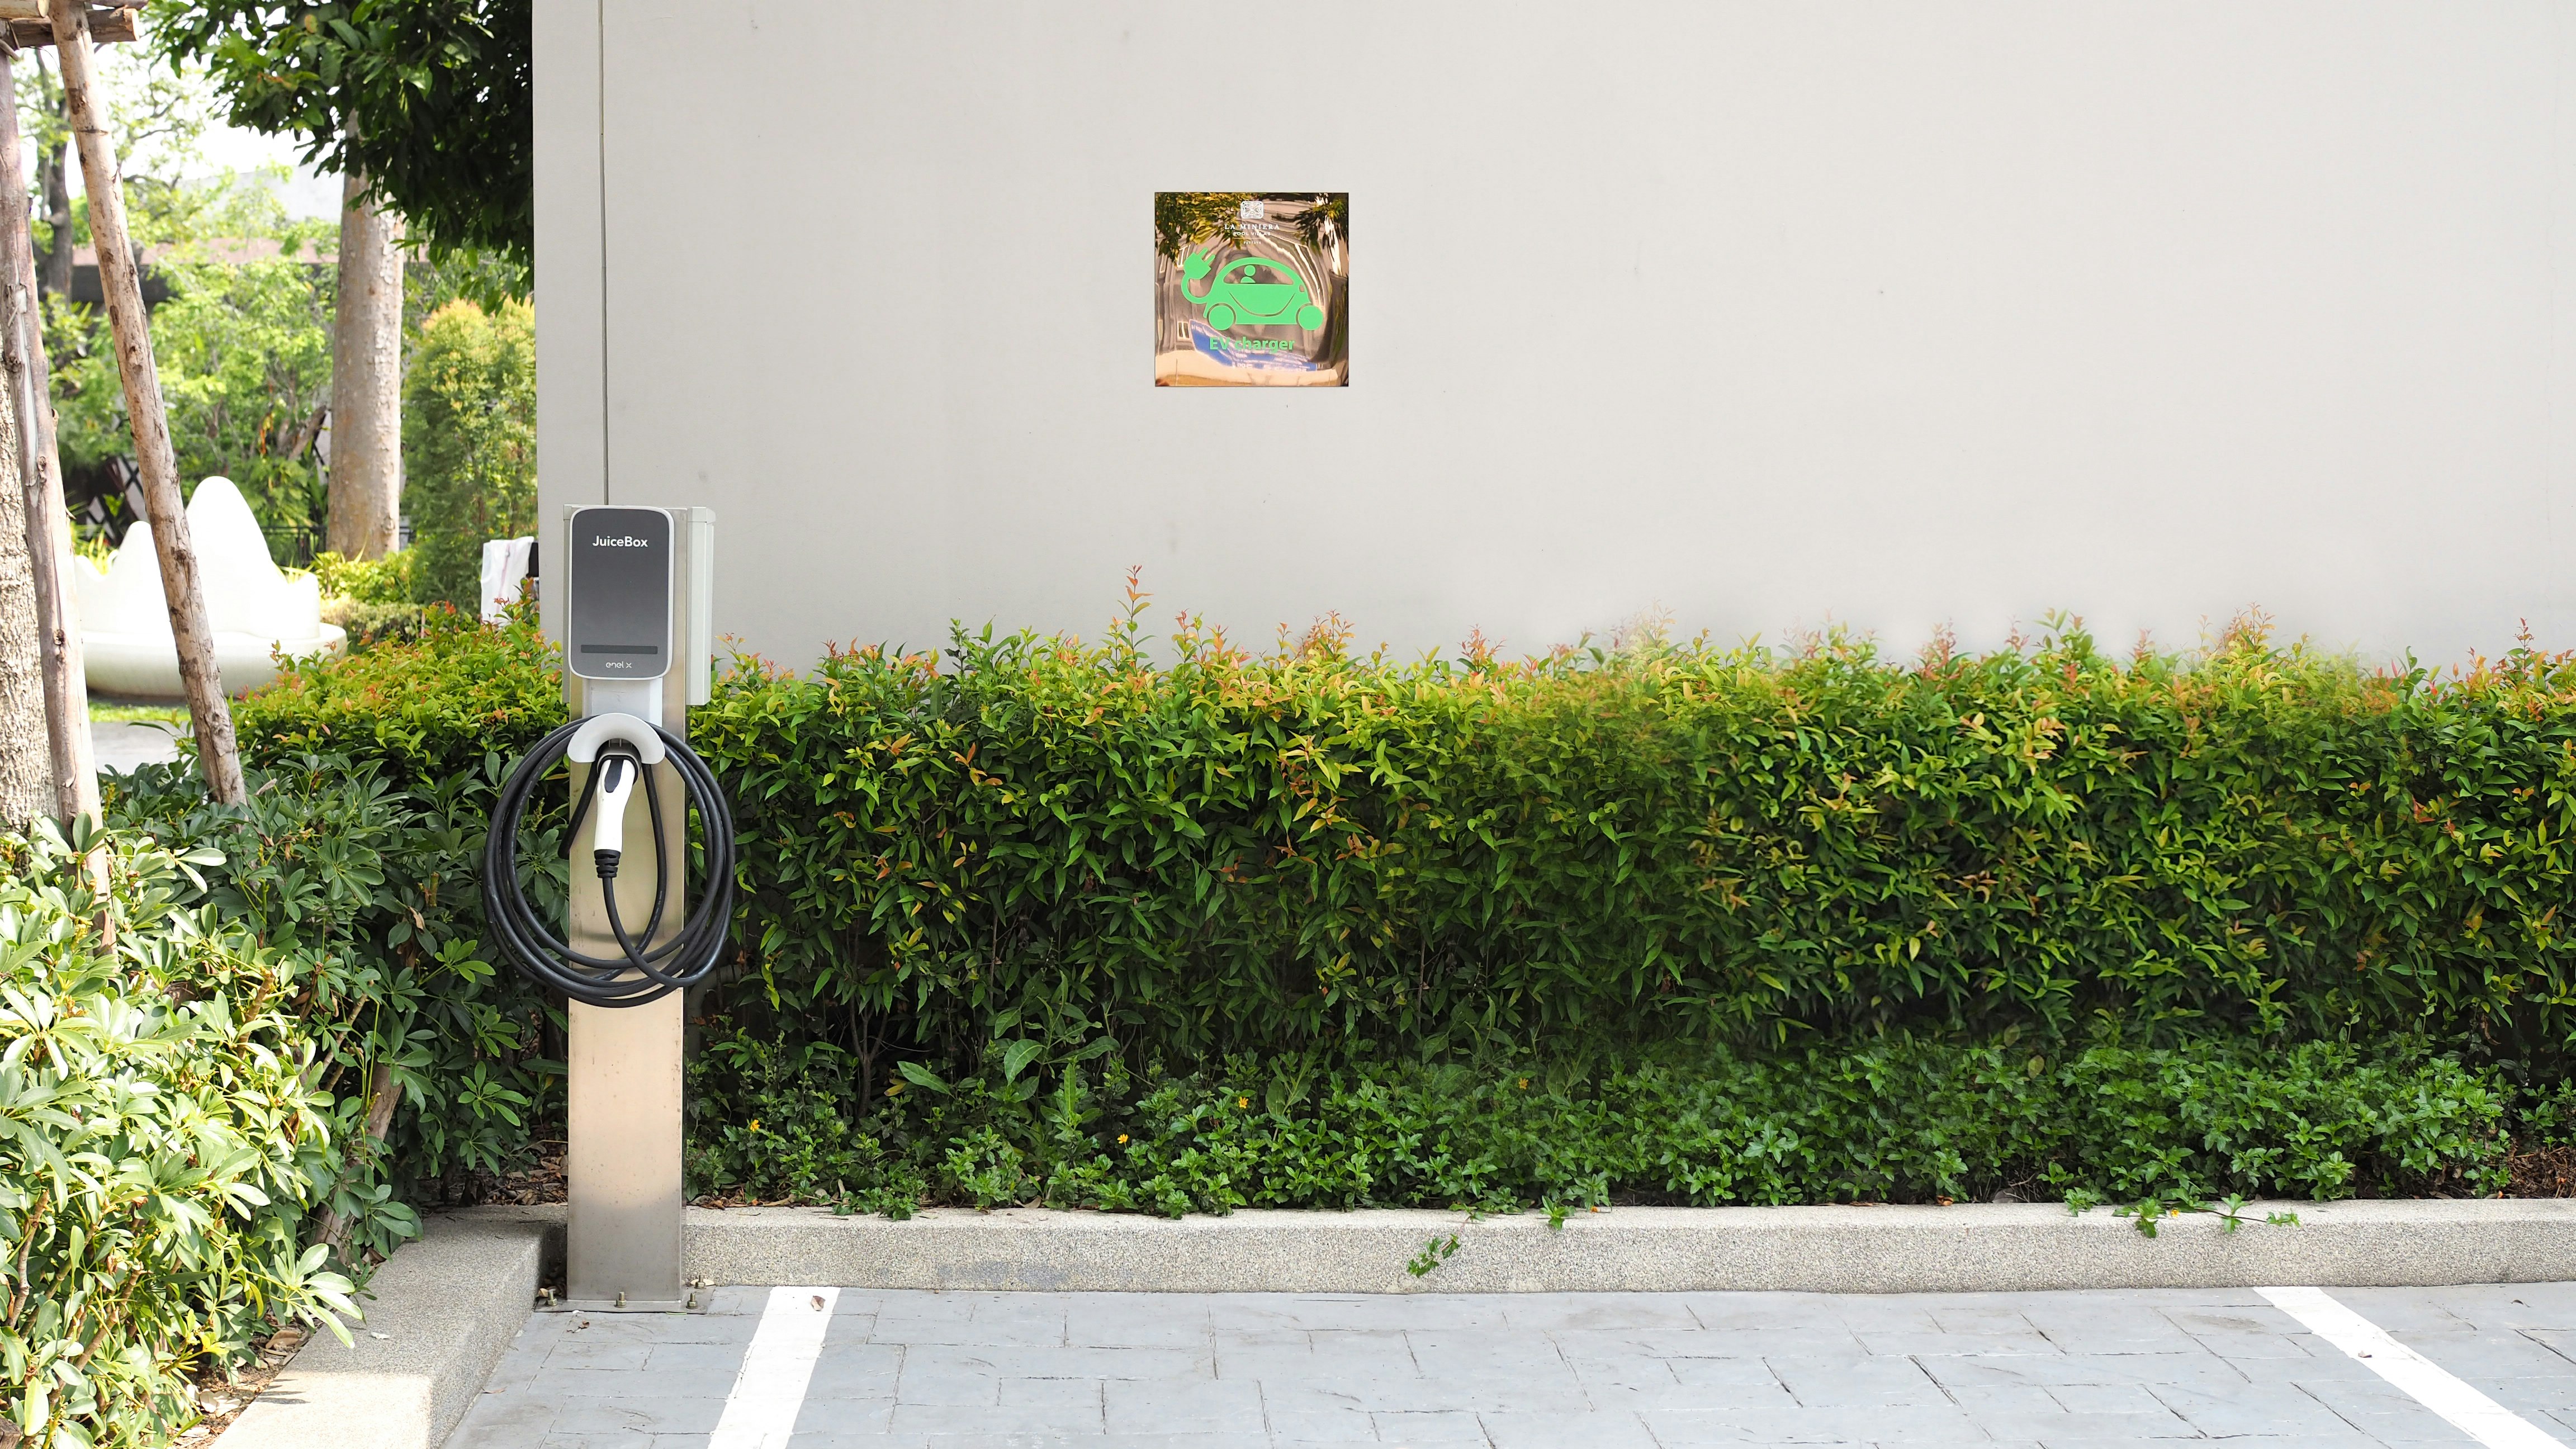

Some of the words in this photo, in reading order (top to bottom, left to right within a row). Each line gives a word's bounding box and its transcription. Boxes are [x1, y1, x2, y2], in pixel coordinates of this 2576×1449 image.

[1209, 337, 1230, 350] EV
[1234, 337, 1295, 353] charger
[592, 535, 648, 547] JuiceBox
